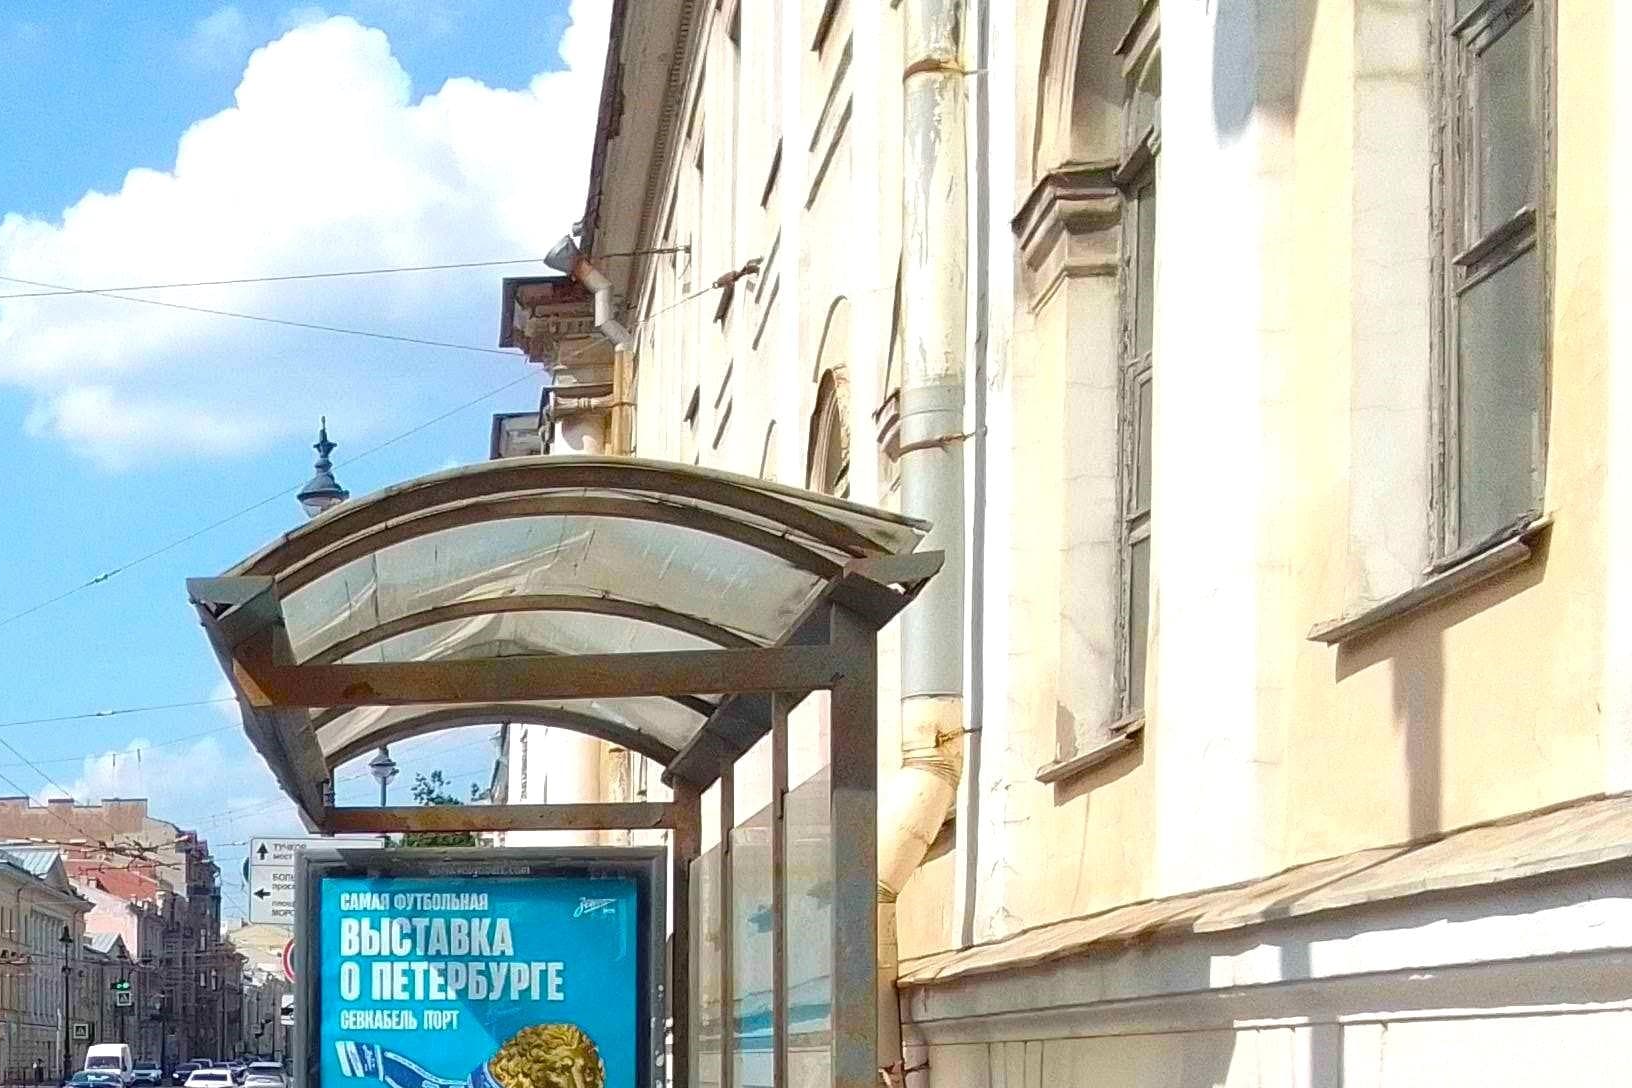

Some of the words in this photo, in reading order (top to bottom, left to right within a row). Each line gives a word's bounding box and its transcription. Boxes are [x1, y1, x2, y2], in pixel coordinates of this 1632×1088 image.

[340, 892, 390, 911] САМАЯ
[393, 893, 489, 911] ФУТБОЛЬНАЯ
[340, 917, 514, 957] ВЫСТАВКА
[340, 962, 361, 1001] О
[371, 961, 565, 1001] ПЕТЕРБУРГЕ
[340, 1009, 418, 1030] СЕВКАБЕЛЬ
[423, 1010, 460, 1030] ПОРТ
